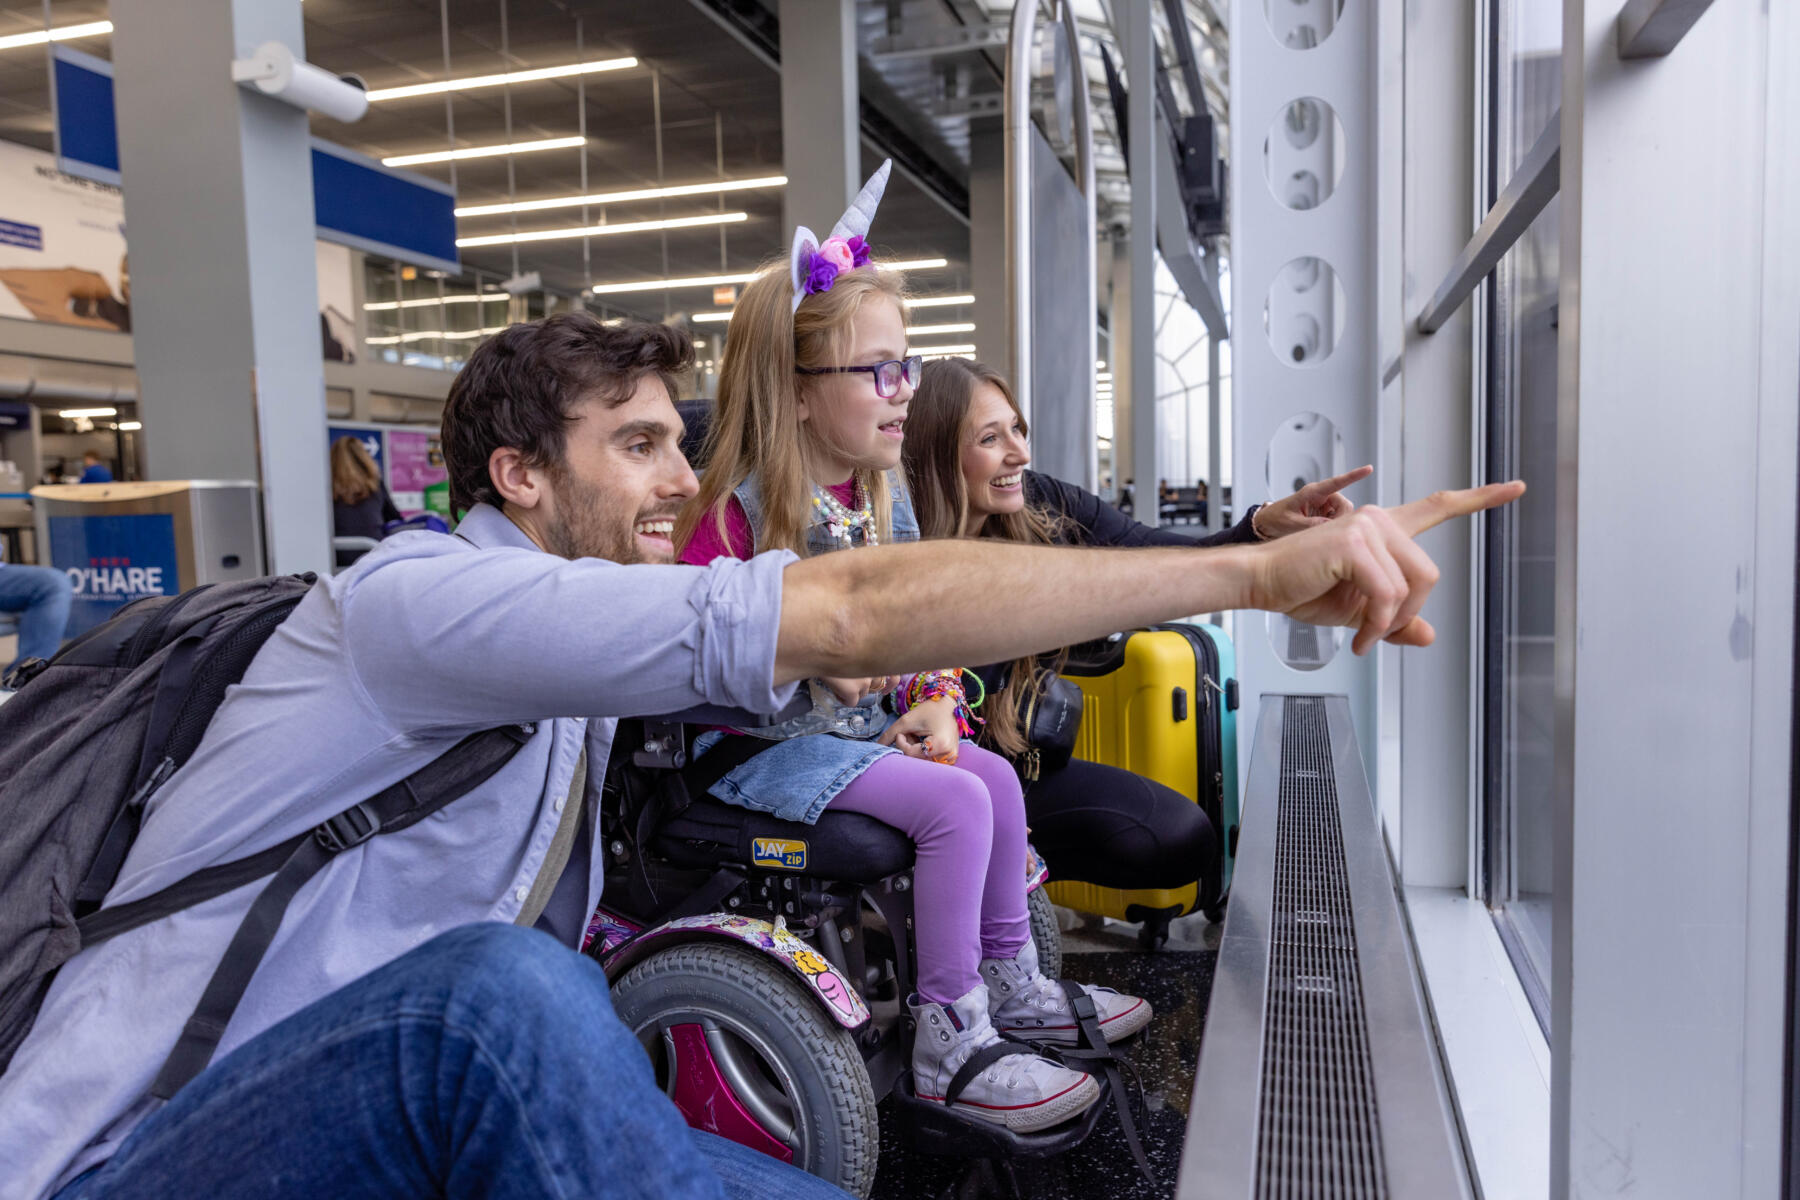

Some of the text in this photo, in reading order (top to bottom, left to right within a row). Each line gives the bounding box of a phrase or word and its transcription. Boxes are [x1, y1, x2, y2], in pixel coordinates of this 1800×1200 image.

[66, 568, 164, 593] O'HARE
[757, 842, 786, 858] JAY
[786, 853, 802, 865] zip
